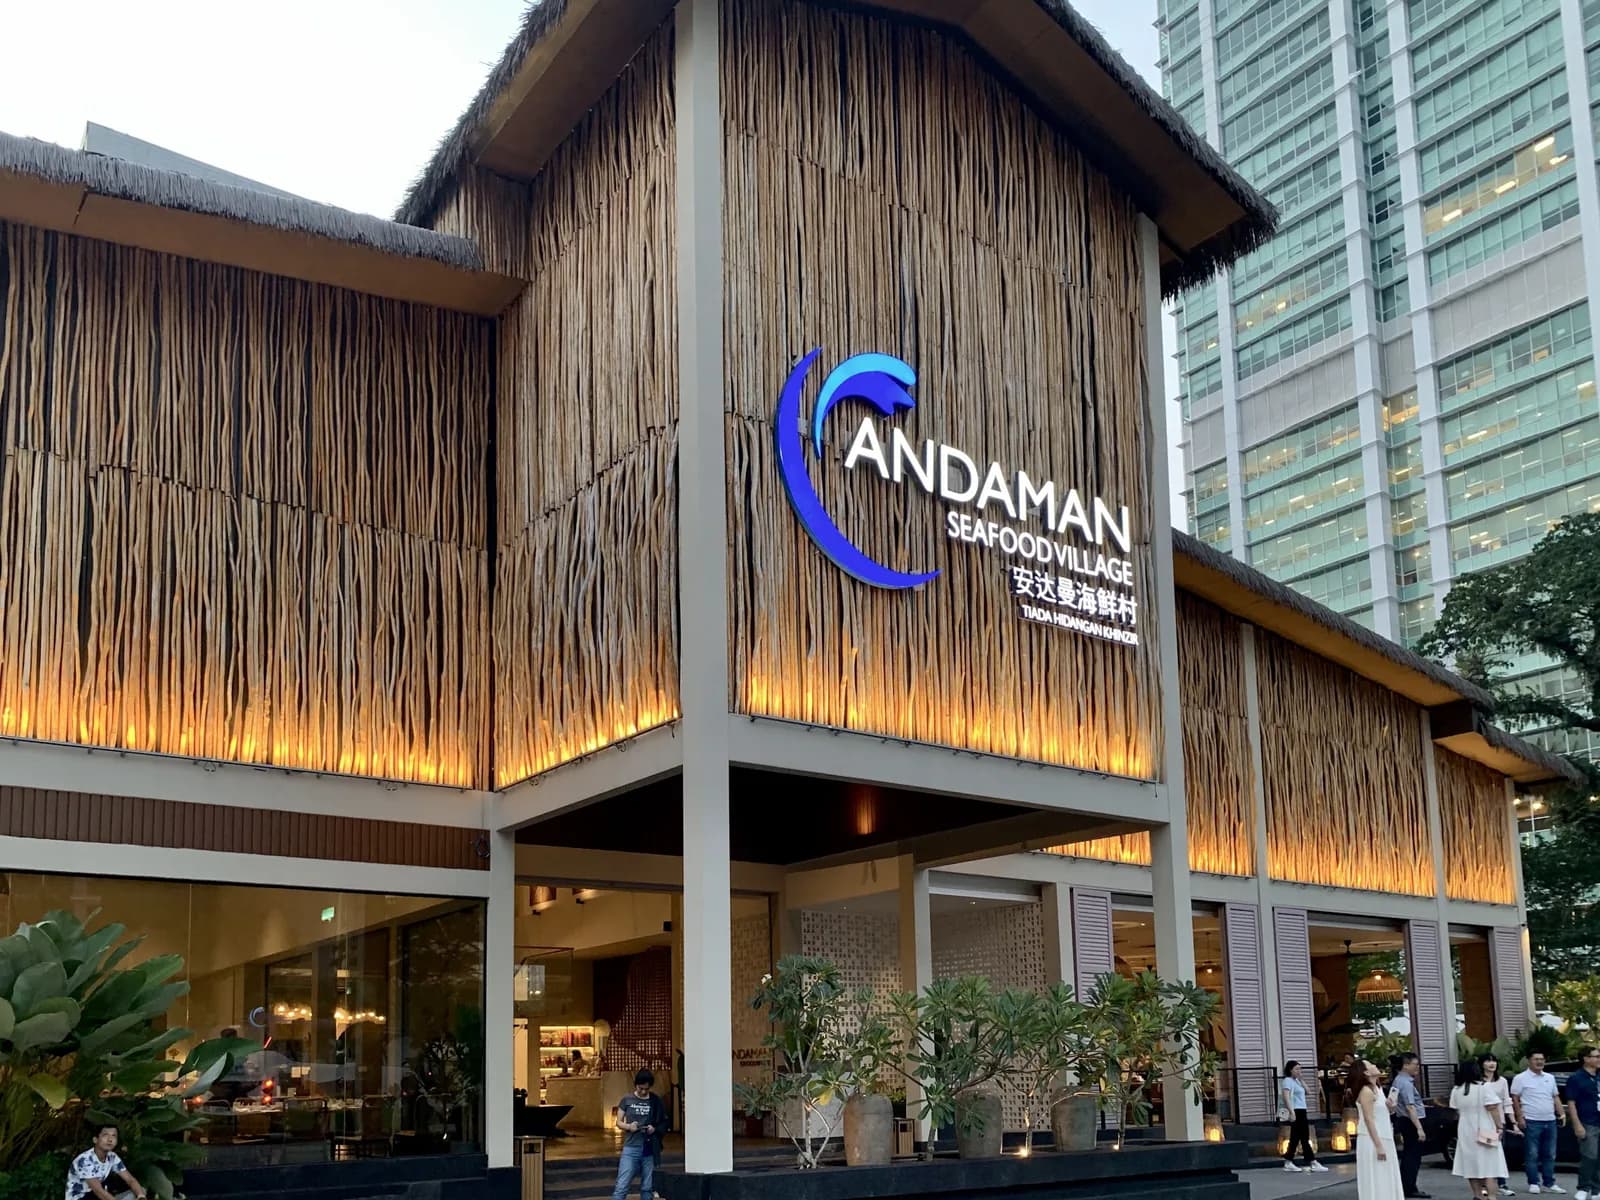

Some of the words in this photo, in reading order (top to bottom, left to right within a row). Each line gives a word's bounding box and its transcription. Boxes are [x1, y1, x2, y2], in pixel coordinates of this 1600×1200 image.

[844, 416, 1131, 553] ANDAMAN
[947, 511, 1052, 563] SEAFOOD
[1053, 541, 1134, 586] VILLAGE
[1012, 565, 1138, 625] 安达曼海鲜村
[1022, 604, 1053, 624] TIADA
[1053, 611, 1102, 637] HIDANGAN
[1102, 625, 1139, 646] KHINZIR
